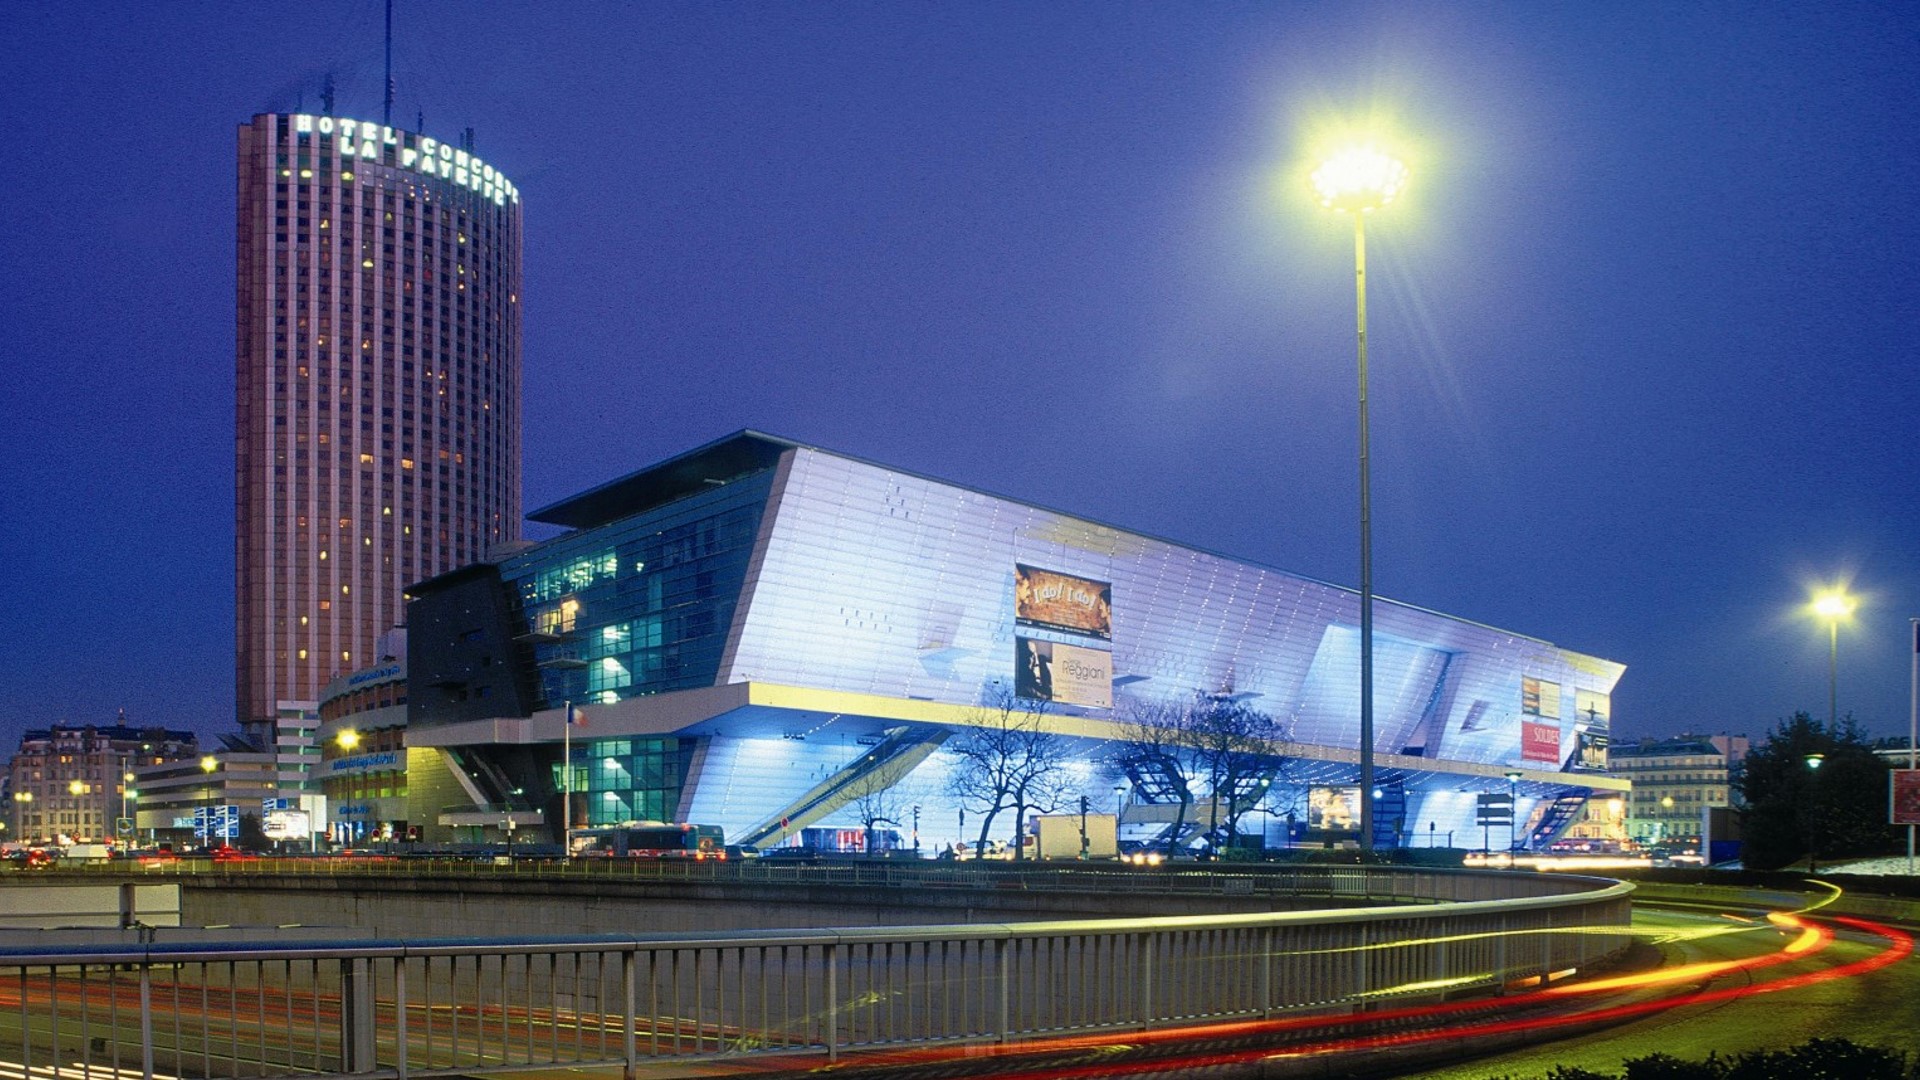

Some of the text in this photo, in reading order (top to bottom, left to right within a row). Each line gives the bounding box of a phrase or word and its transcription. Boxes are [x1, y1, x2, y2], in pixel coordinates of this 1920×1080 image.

[297, 114, 519, 205] HOTEL CONCORDE
[340, 136, 504, 206] LA FAYETTE
[1062, 660, 1105, 681] Reggiani
